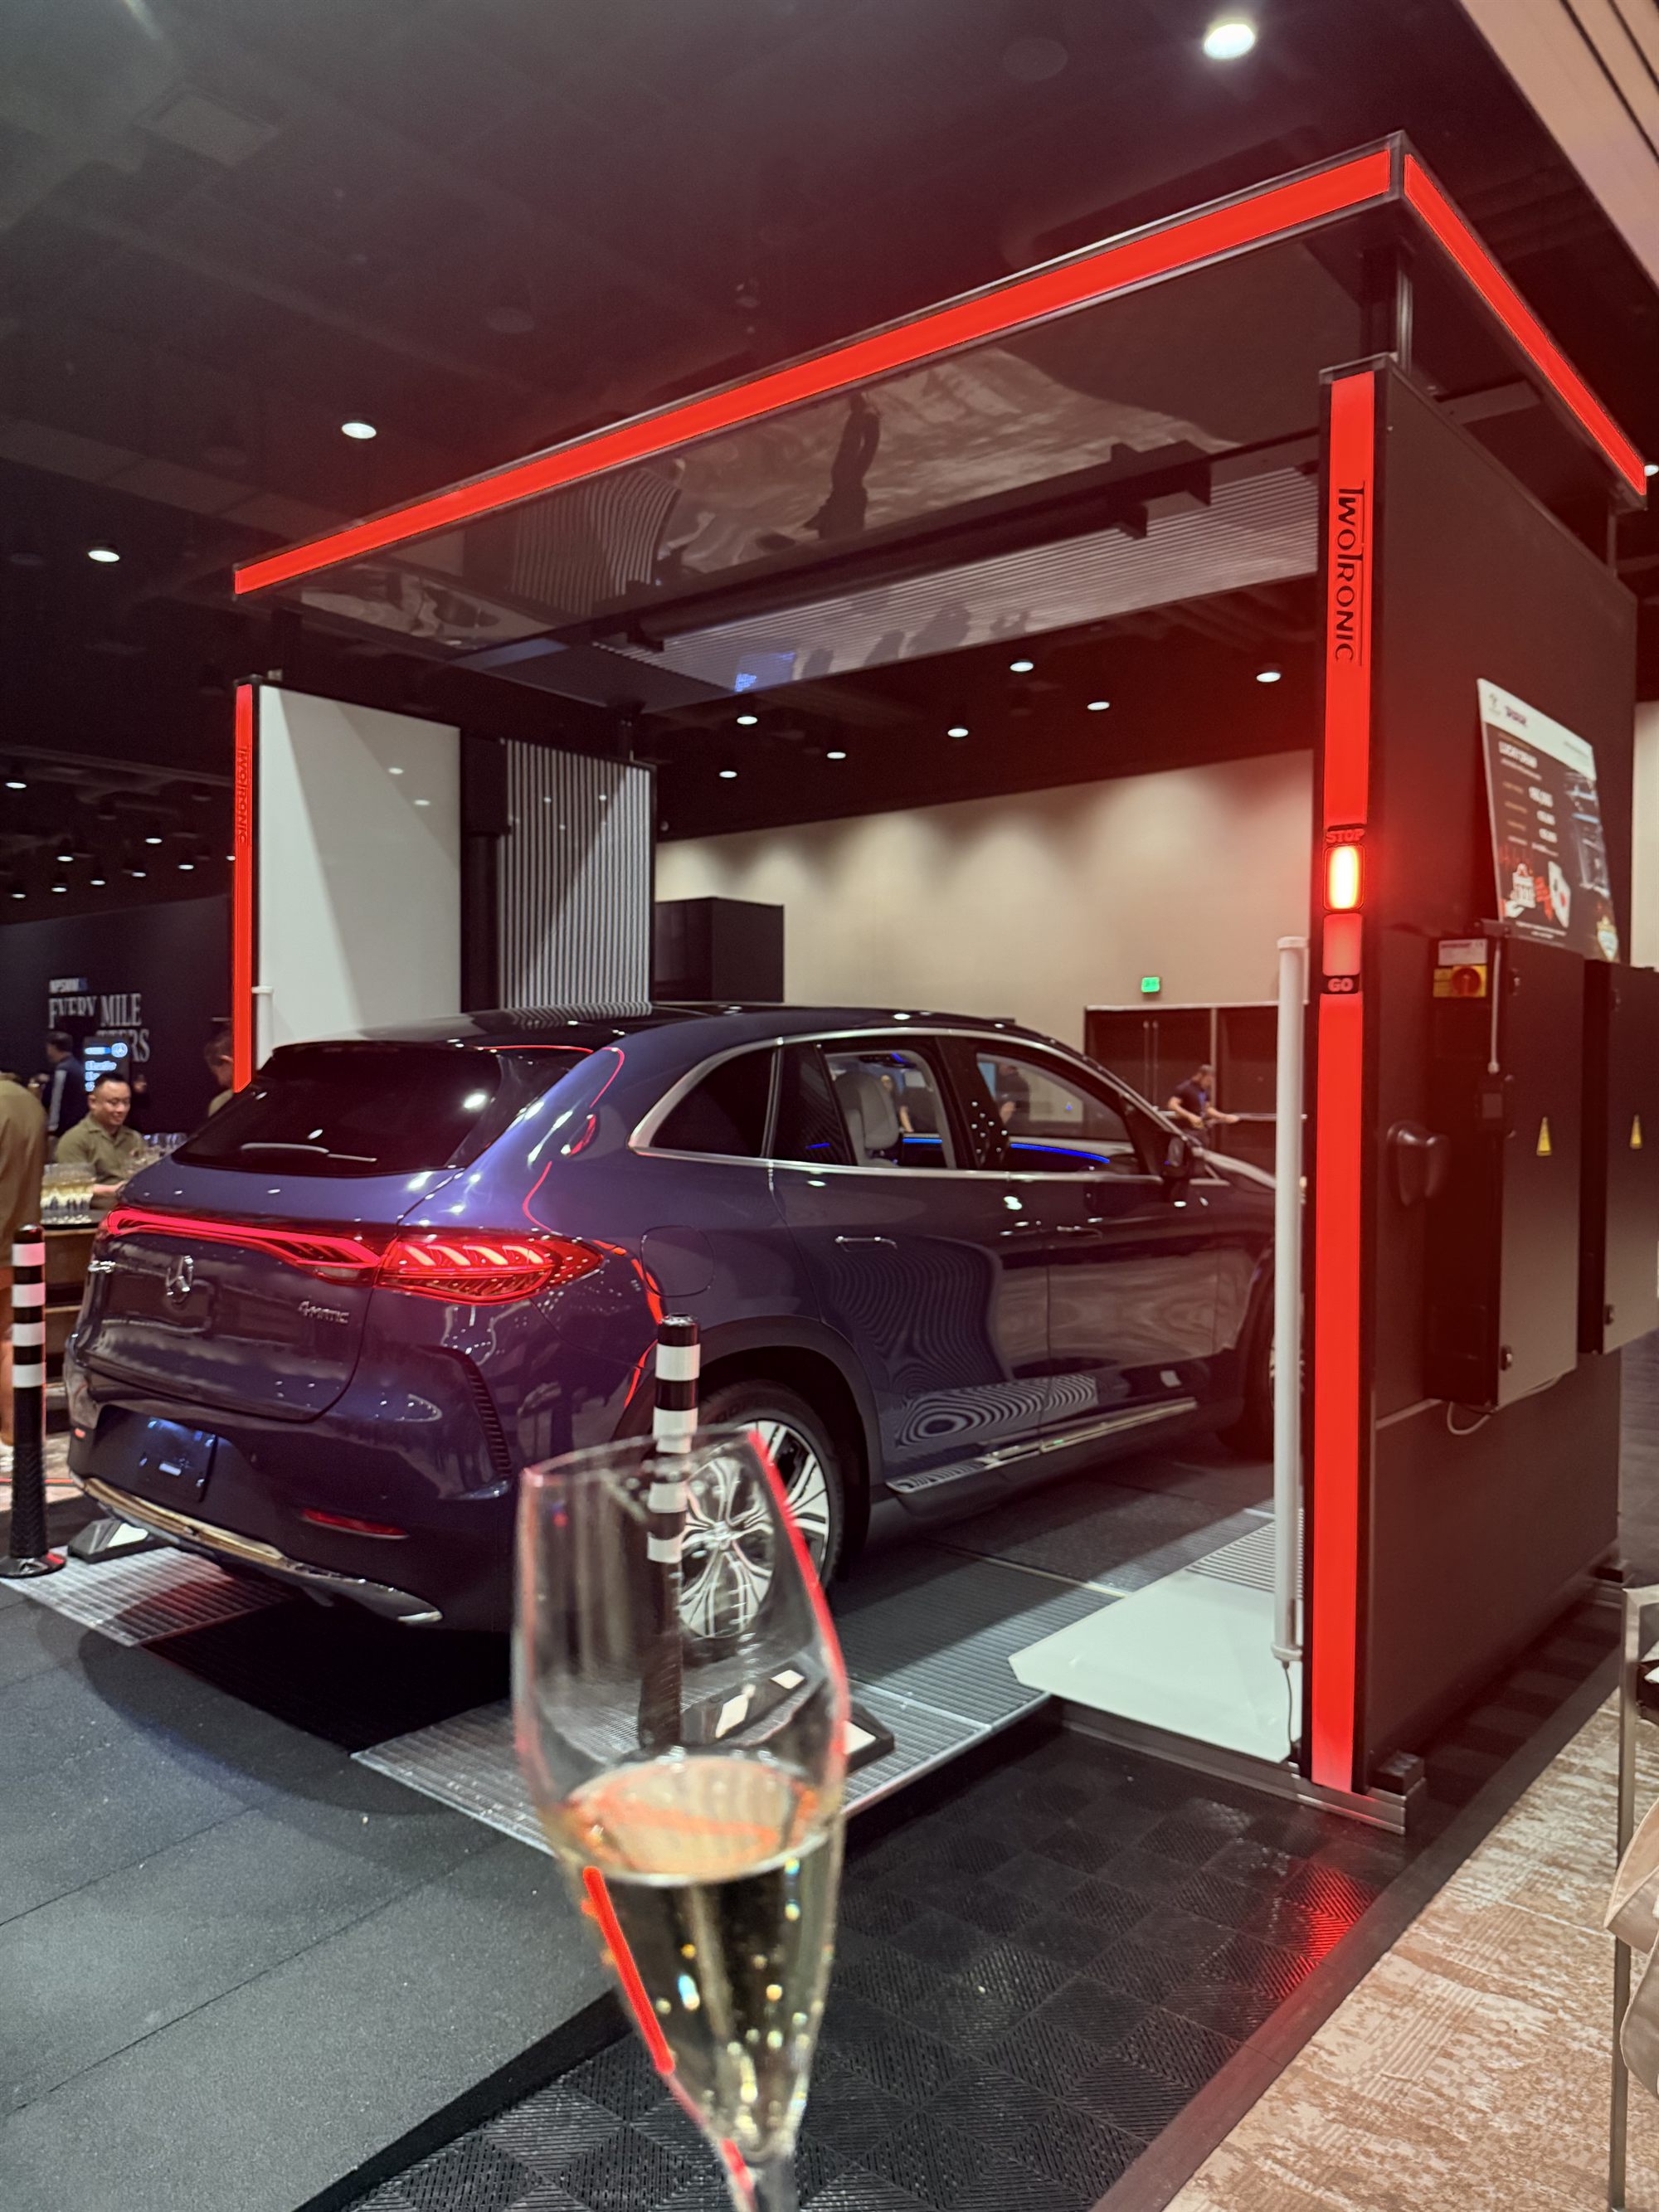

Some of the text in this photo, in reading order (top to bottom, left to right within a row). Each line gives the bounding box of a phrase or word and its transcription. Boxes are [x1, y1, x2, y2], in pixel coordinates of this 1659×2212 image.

[1326, 829, 1365, 843] STOP
[1328, 978, 1354, 992] GO
[100, 993, 142, 1027] MILE
